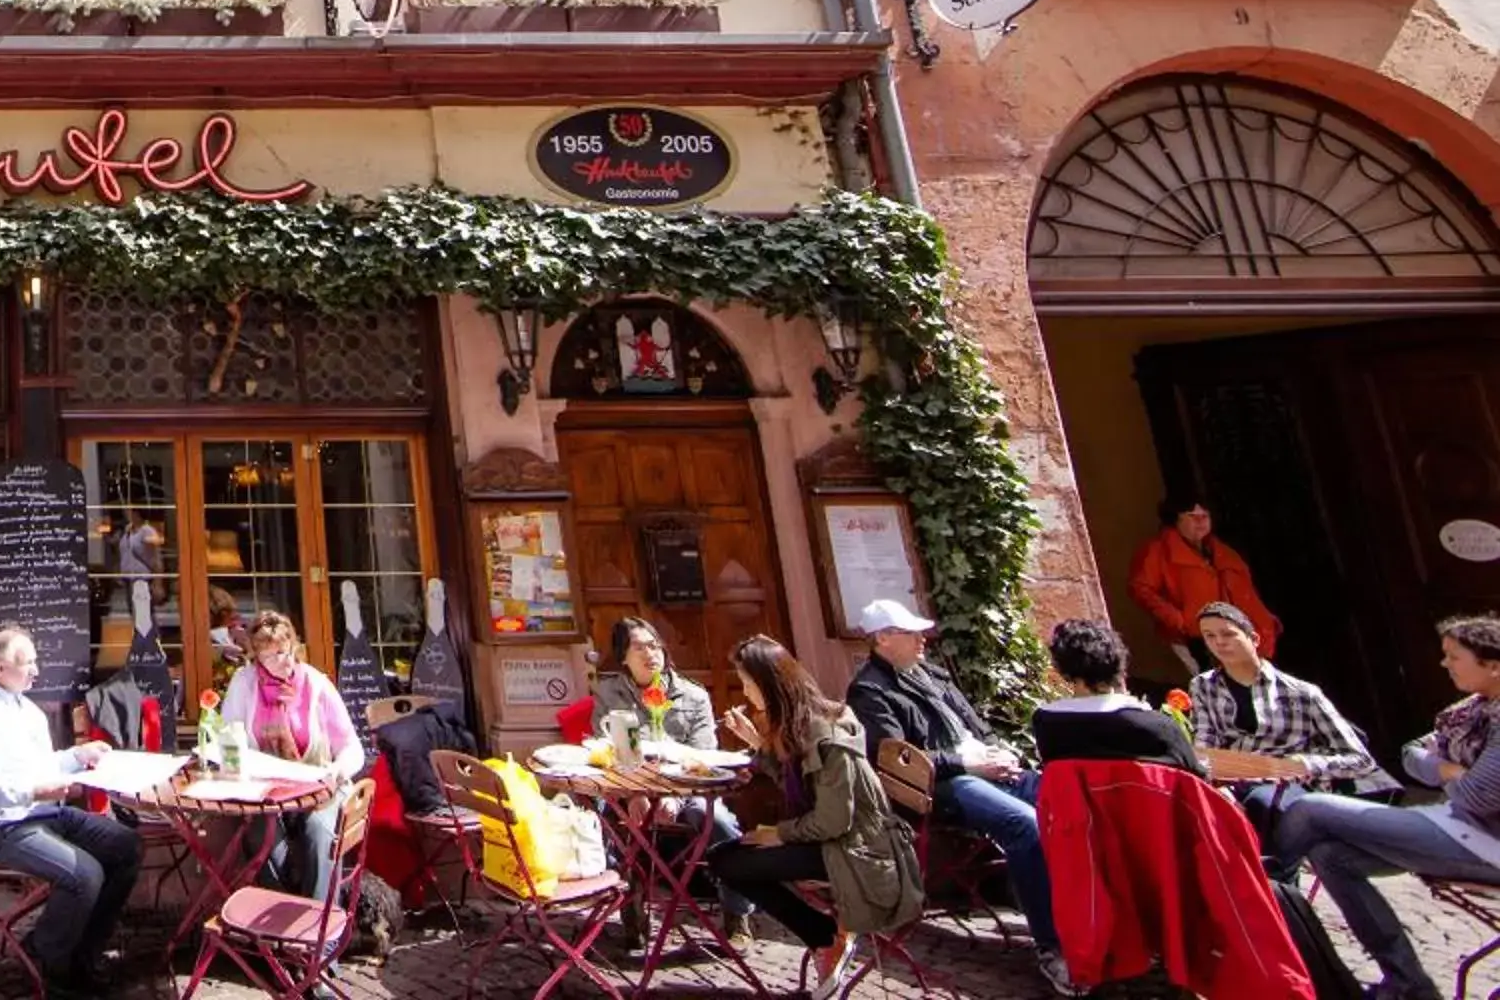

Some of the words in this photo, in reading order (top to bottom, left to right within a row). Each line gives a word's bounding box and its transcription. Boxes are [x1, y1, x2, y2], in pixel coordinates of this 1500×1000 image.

[618, 115, 643, 136] 50
[550, 135, 604, 154] 1955
[660, 135, 714, 154] 2005
[605, 187, 680, 200] Gastronomie
